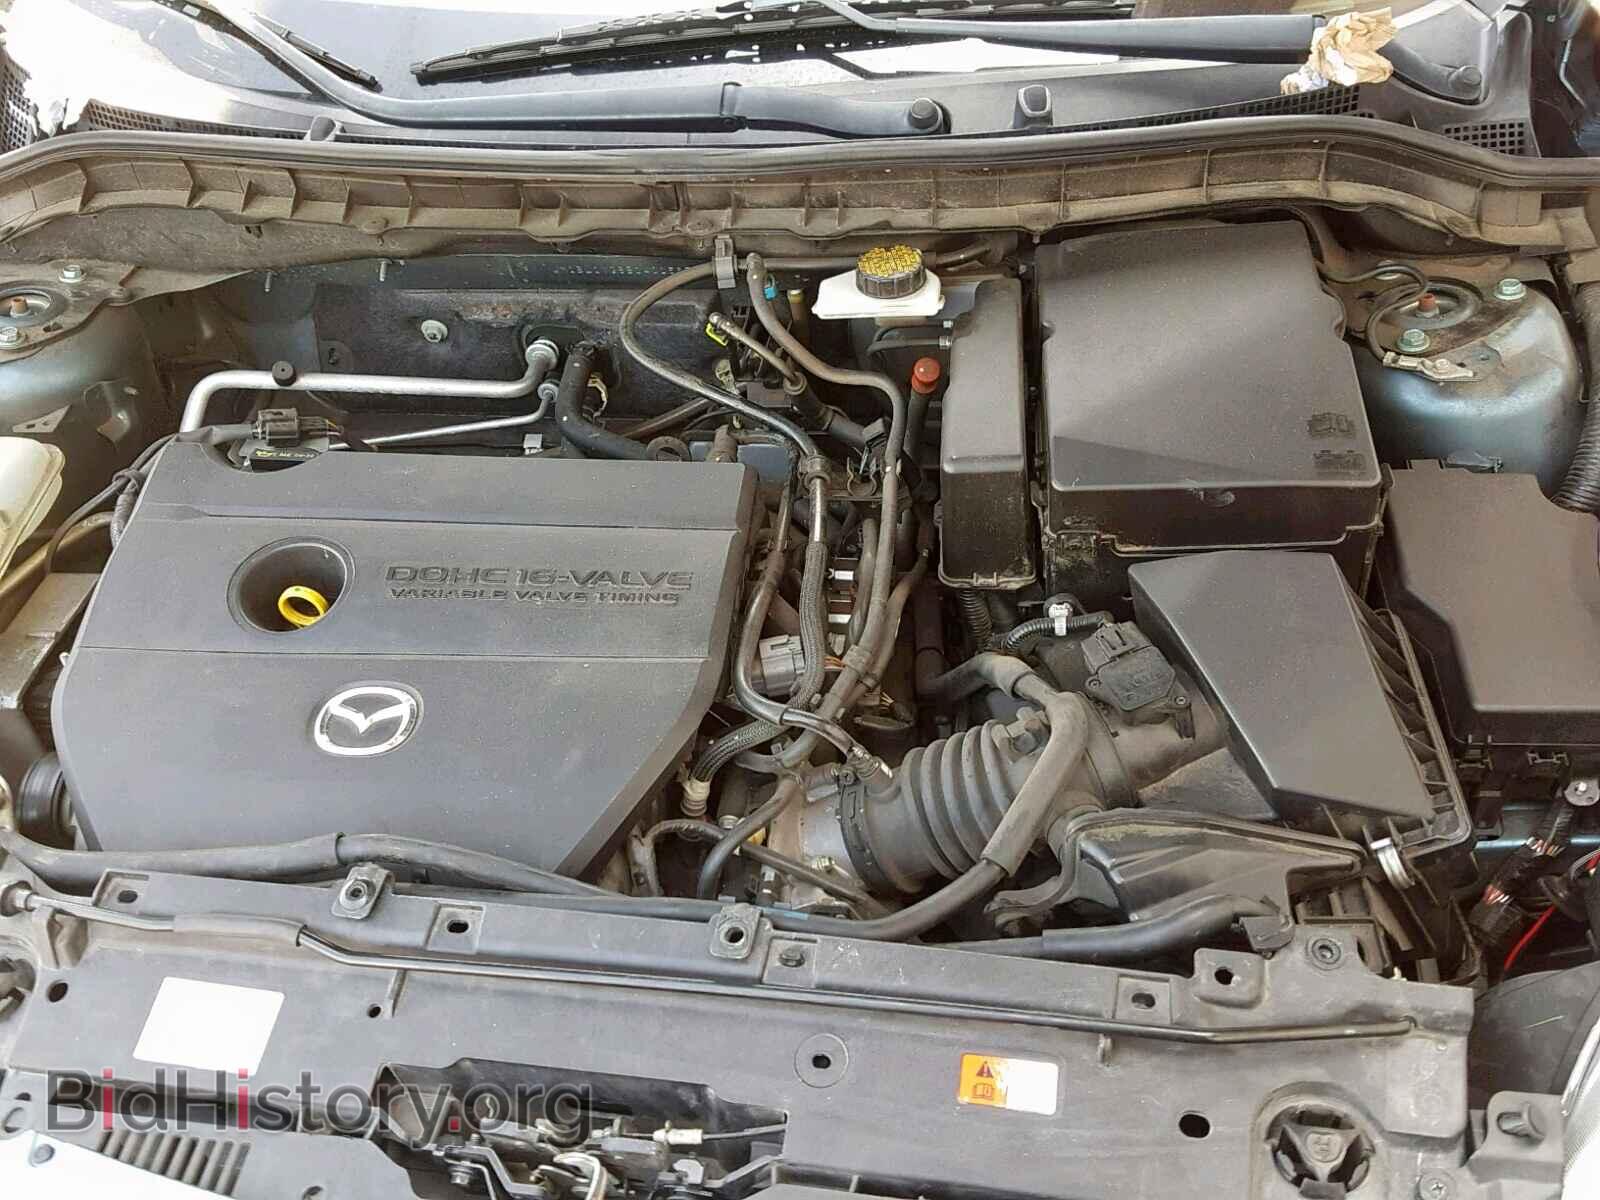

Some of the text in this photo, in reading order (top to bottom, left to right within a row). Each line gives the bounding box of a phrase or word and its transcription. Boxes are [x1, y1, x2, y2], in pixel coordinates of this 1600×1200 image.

[385, 566, 694, 590] DOHC 16-VALVE
[391, 588, 680, 604] VARIABLE VALVE TIMING
